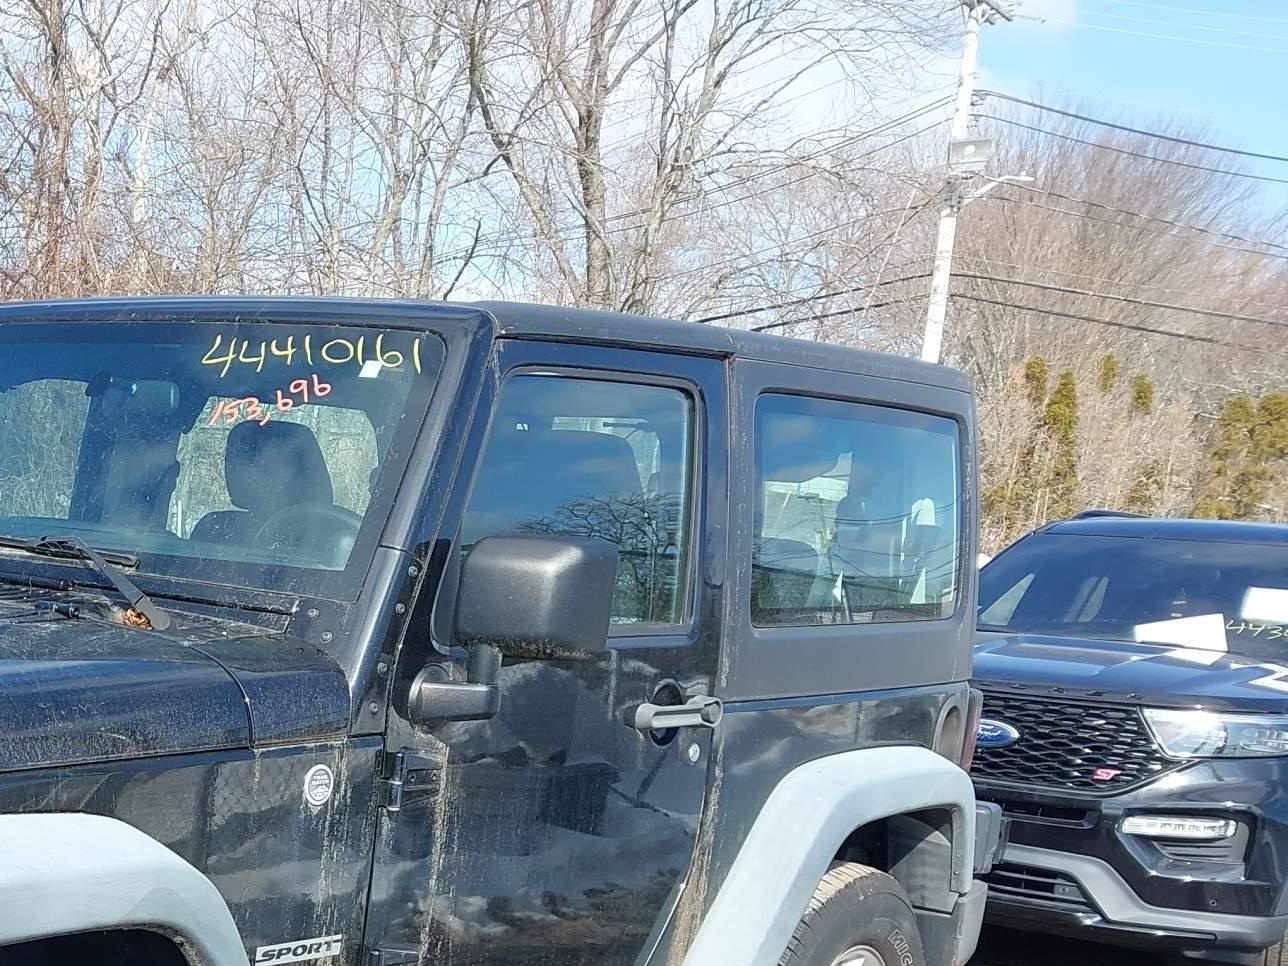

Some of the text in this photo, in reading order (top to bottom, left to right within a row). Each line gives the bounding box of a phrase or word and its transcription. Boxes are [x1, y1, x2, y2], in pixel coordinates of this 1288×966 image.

[202, 334, 421, 378] 44410161
[208, 373, 331, 426] 153,696
[256, 939, 342, 963] SPORT
